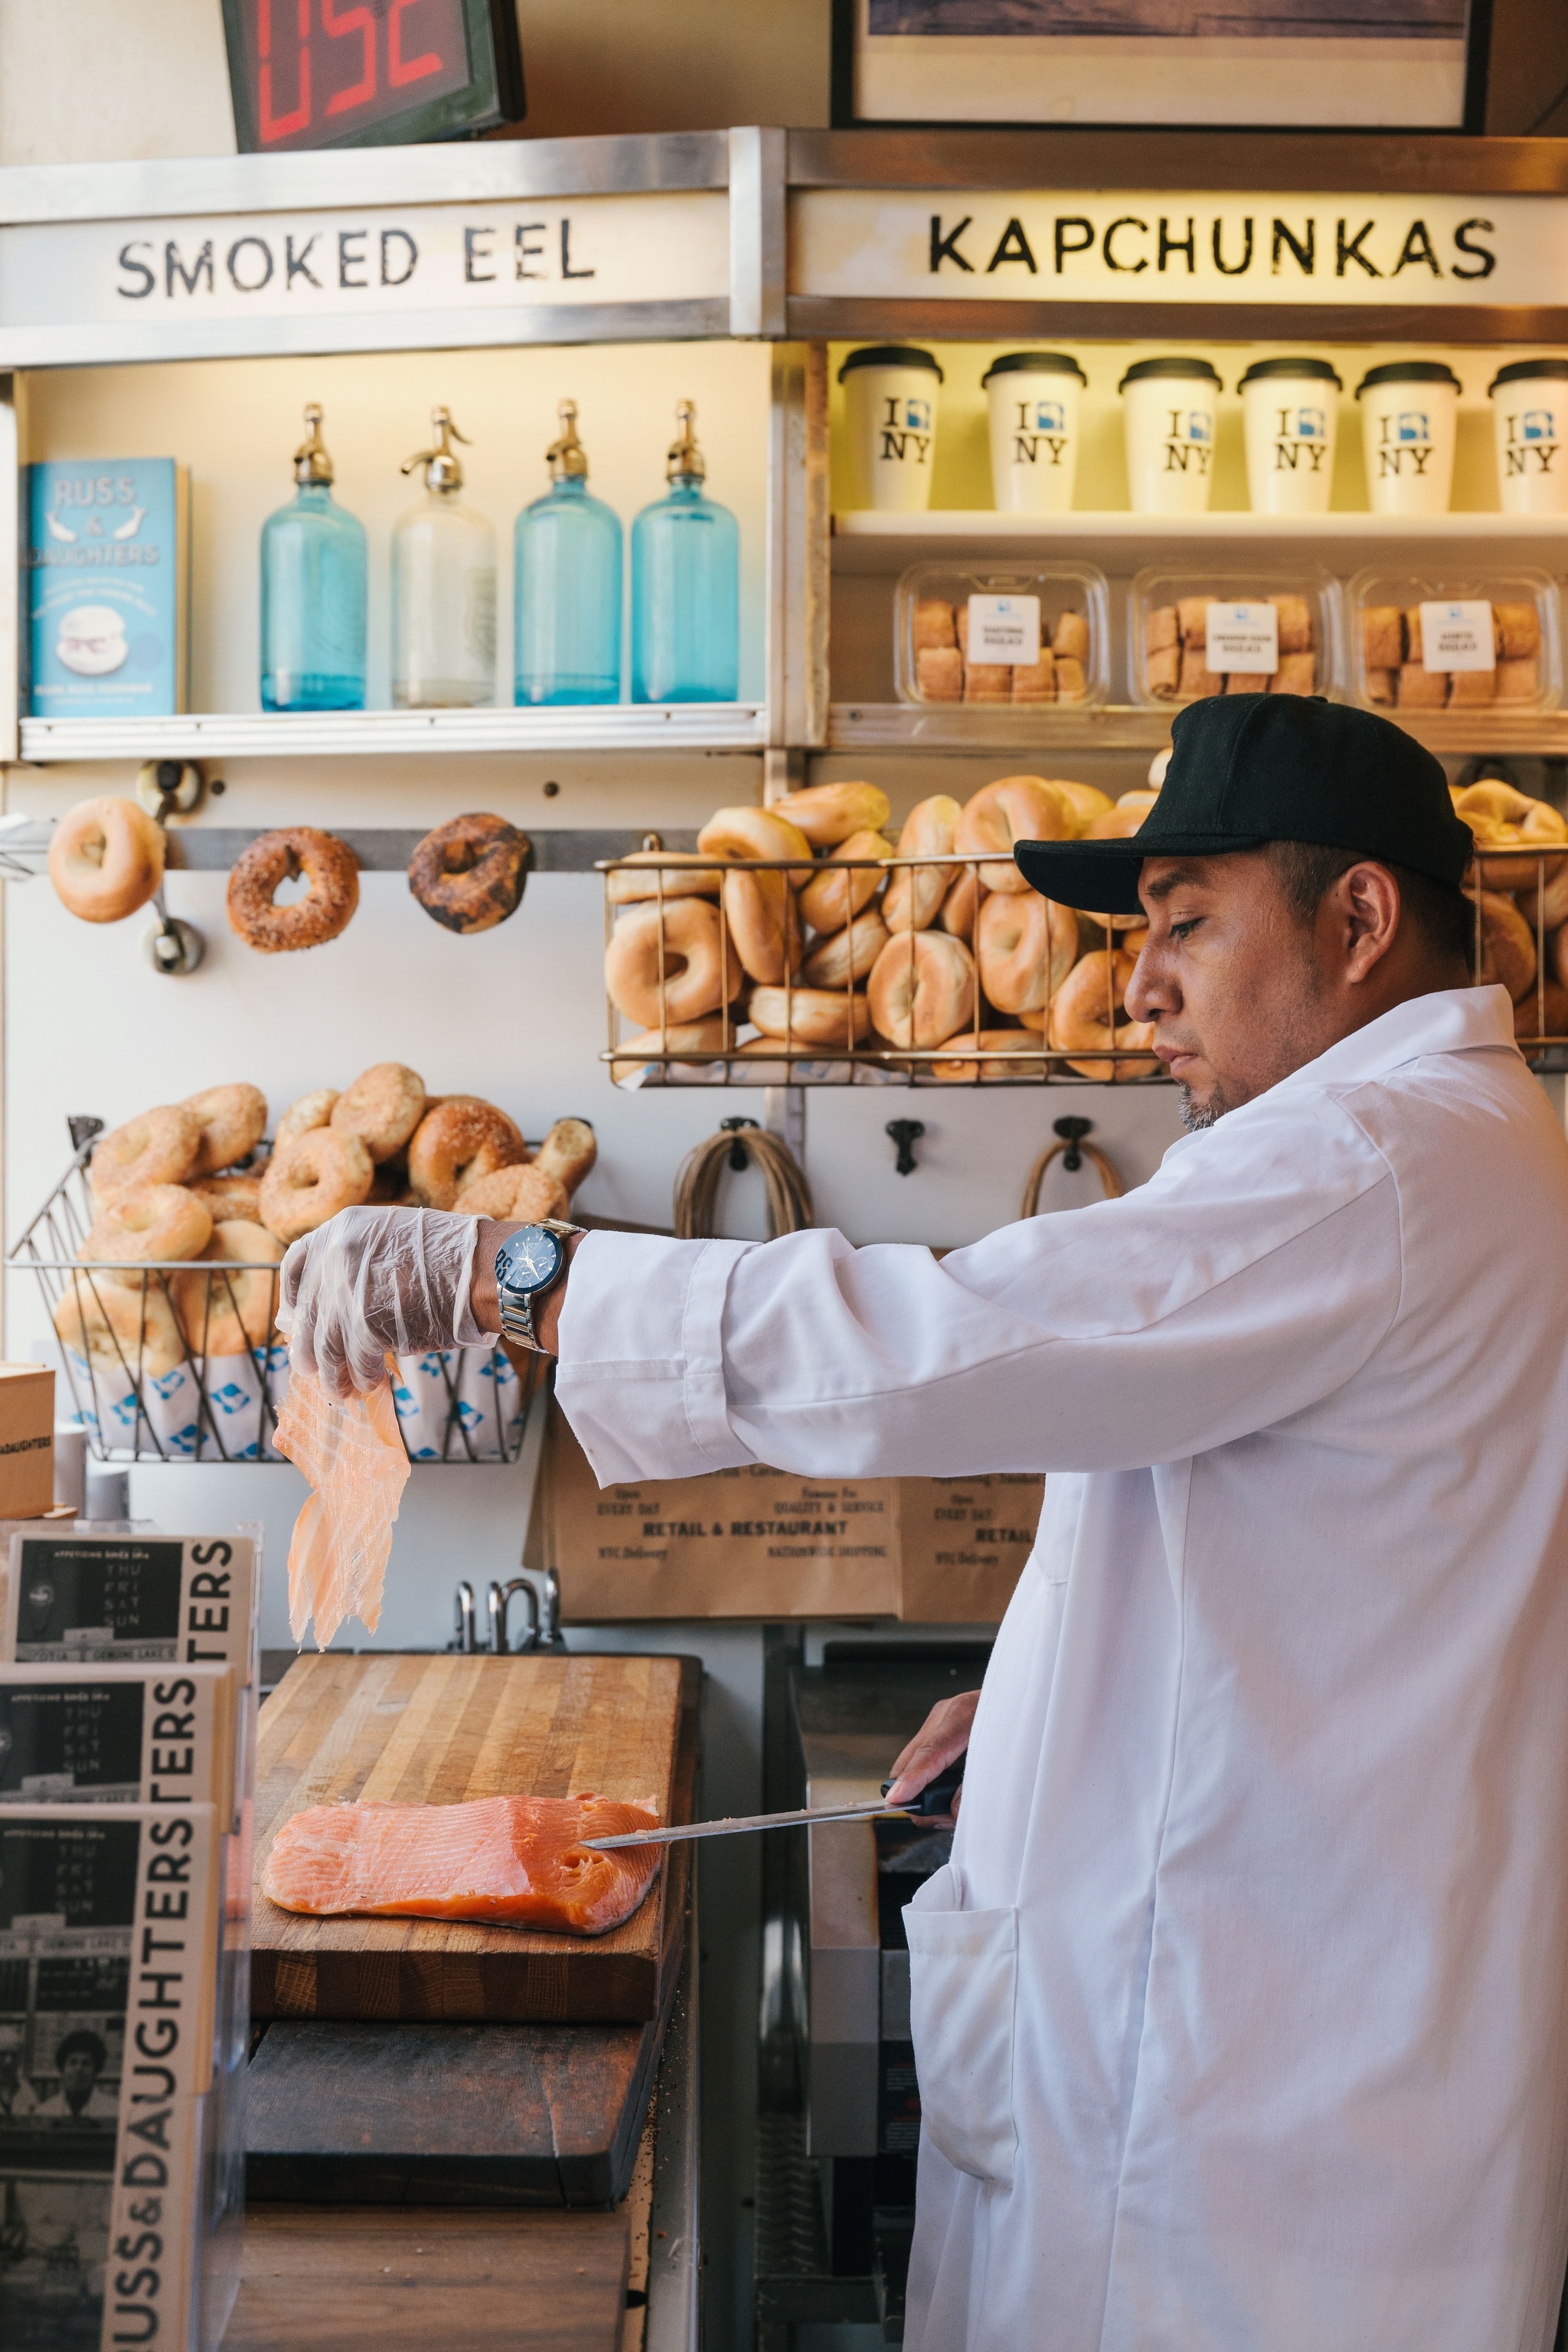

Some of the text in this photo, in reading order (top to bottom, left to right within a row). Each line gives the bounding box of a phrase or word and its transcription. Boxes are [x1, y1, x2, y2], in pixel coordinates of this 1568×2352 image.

[117, 219, 596, 299] SMOKED EEL
[929, 215, 1497, 279] KAPCHUNKAS
[880, 431, 930, 464] NY
[1014, 436, 1067, 466] NY
[1165, 443, 1211, 475] NY
[1274, 443, 1326, 472] NY
[1378, 447, 1433, 478] NY
[1505, 445, 1557, 477] NY
[54, 475, 138, 508] RUSS
[642, 1521, 707, 1537] RETAIL
[730, 1520, 847, 1537] RESTAURANT
[975, 1527, 1032, 1543] RETAIL
